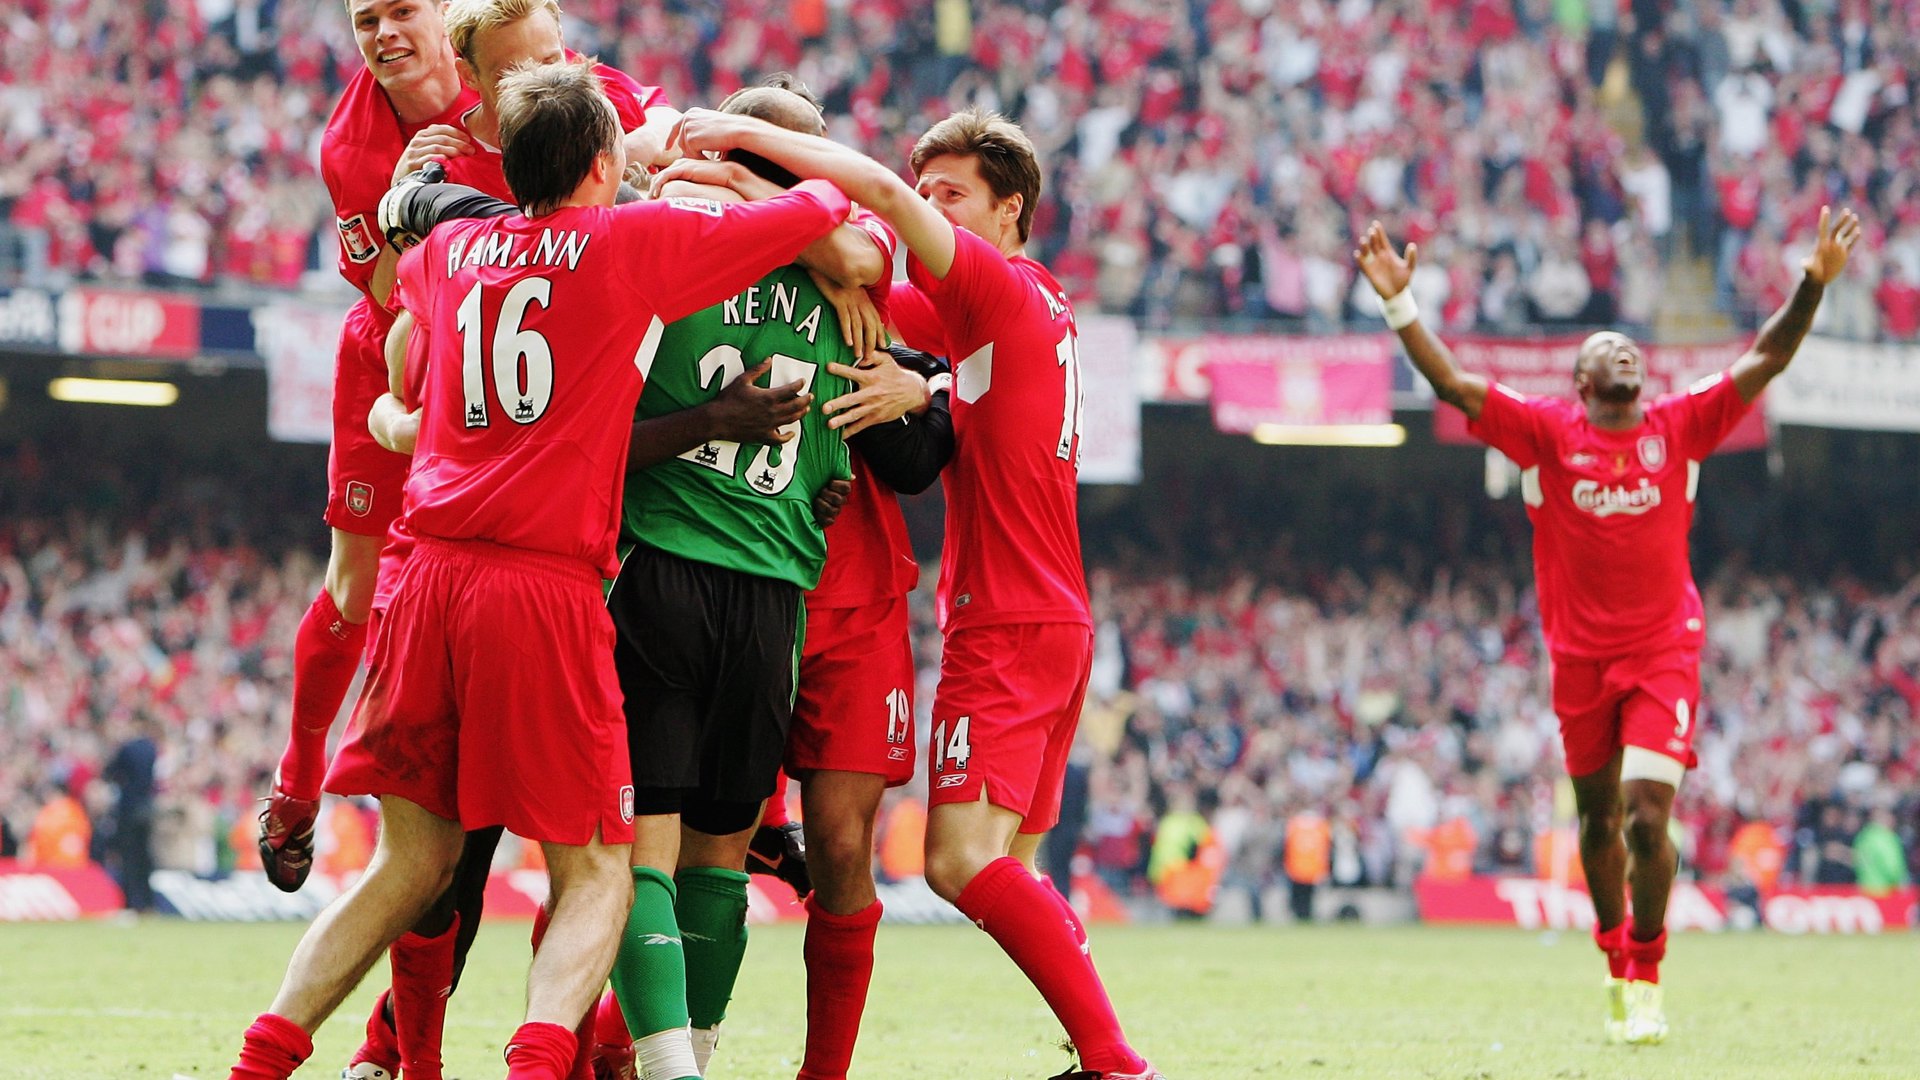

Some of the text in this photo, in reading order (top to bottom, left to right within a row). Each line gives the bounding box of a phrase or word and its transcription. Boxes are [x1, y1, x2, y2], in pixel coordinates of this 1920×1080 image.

[456, 276, 555, 429] 16
[1571, 477, 1662, 518] Carlsberg
[885, 686, 910, 744] 19
[1674, 697, 1690, 738] 9
[934, 715, 971, 774] 14
